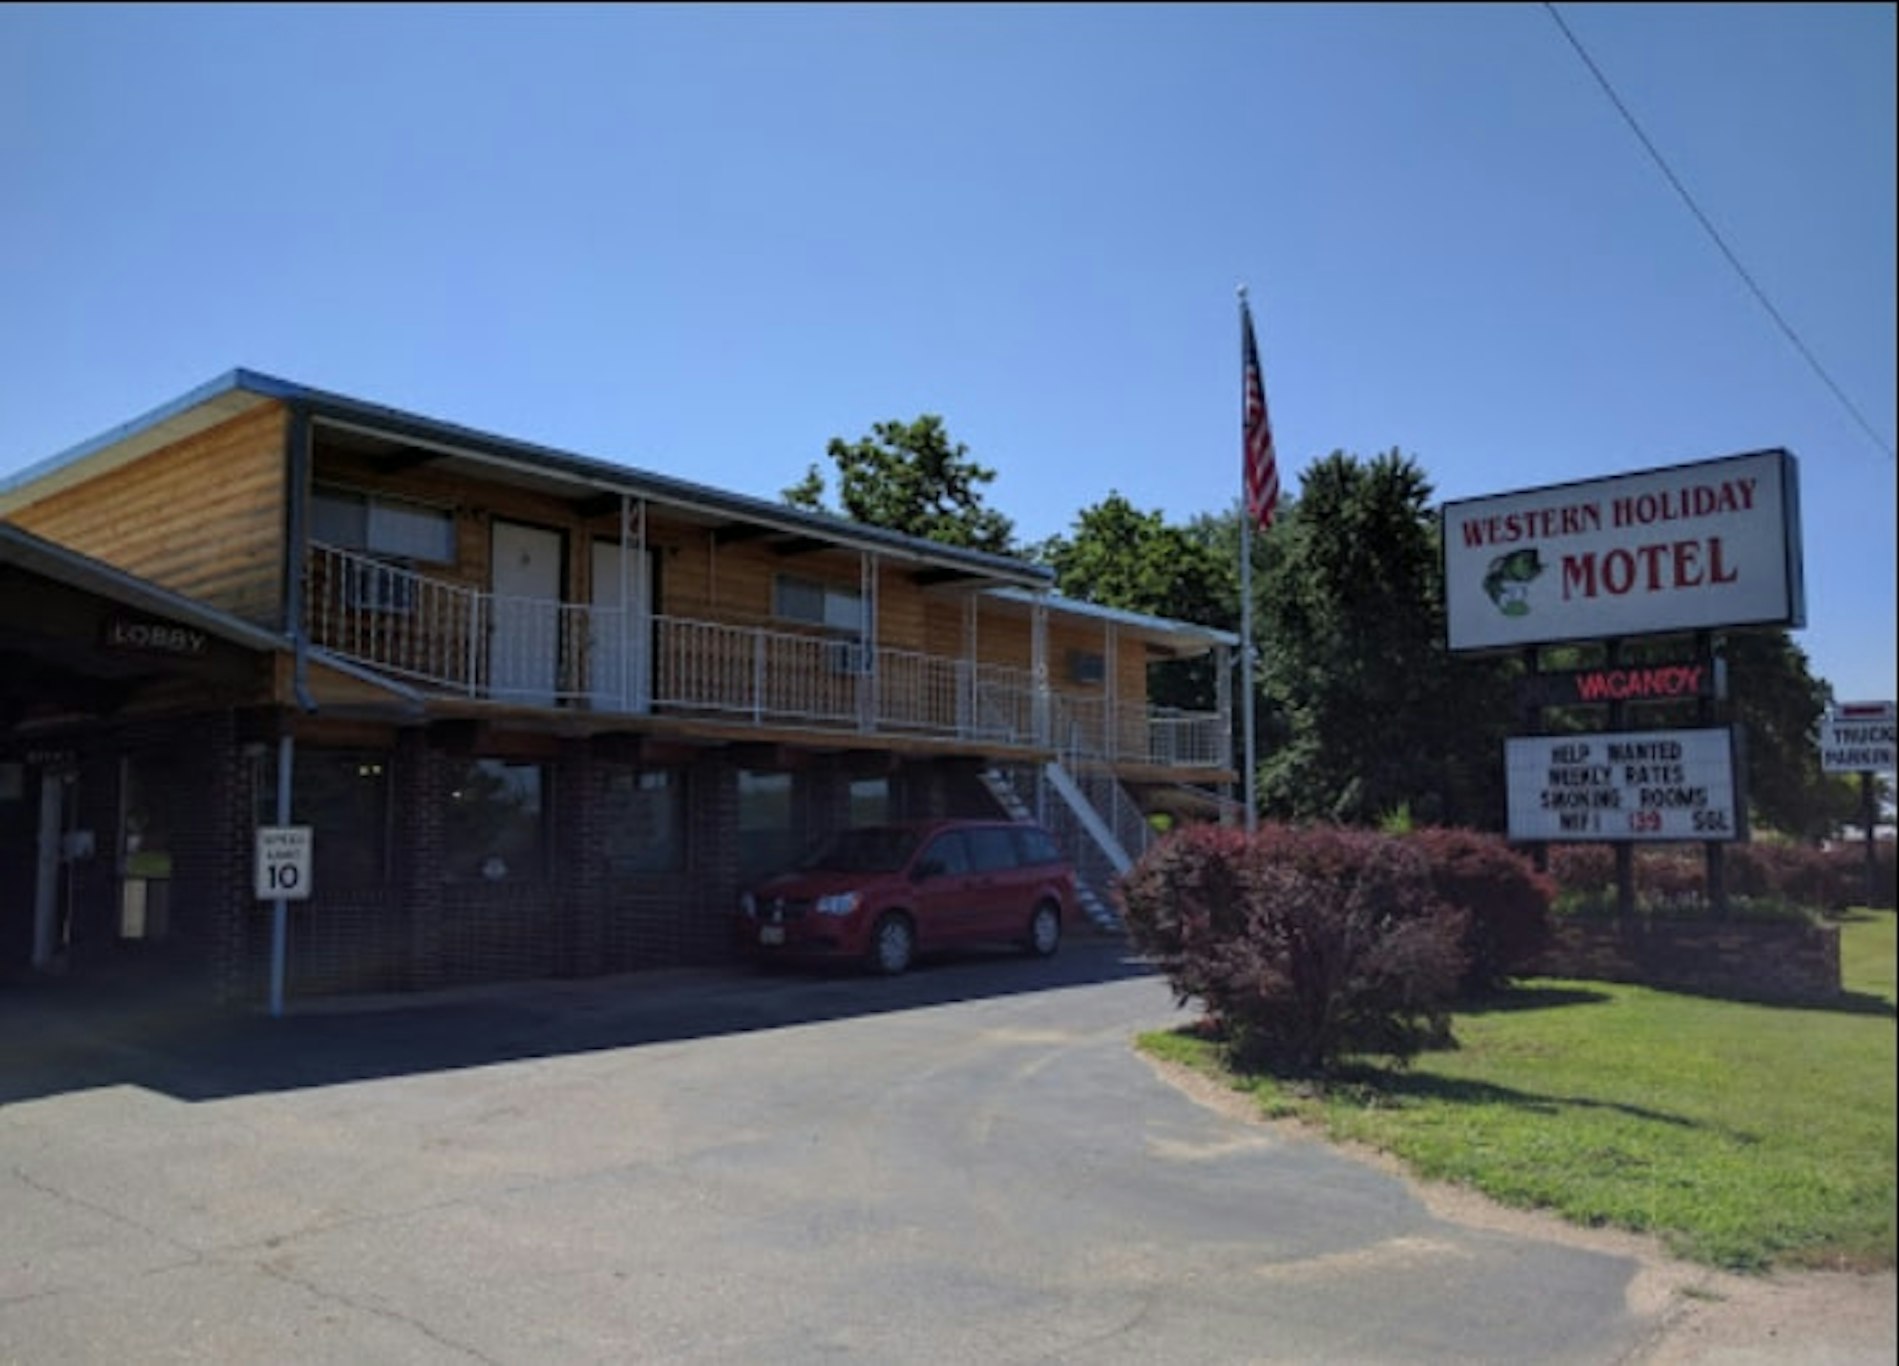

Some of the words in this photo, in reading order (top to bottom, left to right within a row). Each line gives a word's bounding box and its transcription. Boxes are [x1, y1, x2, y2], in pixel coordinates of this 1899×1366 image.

[1462, 504, 1601, 548] WESTERN
[1612, 477, 1756, 528] HOLIDAY
[1562, 537, 1738, 600] MOTEL
[112, 620, 207, 652] LOBBY
[1576, 666, 1704, 699] VACANCY
[1551, 743, 1590, 764] HELP
[1607, 741, 1682, 761] WANTED
[1549, 766, 1612, 785] WEEKLY
[1626, 764, 1685, 784] RATES
[1540, 788, 1620, 809] SMOKING
[1640, 786, 1708, 807] ROOMS
[1692, 810, 1729, 831] SGL
[268, 863, 299, 890] 10
